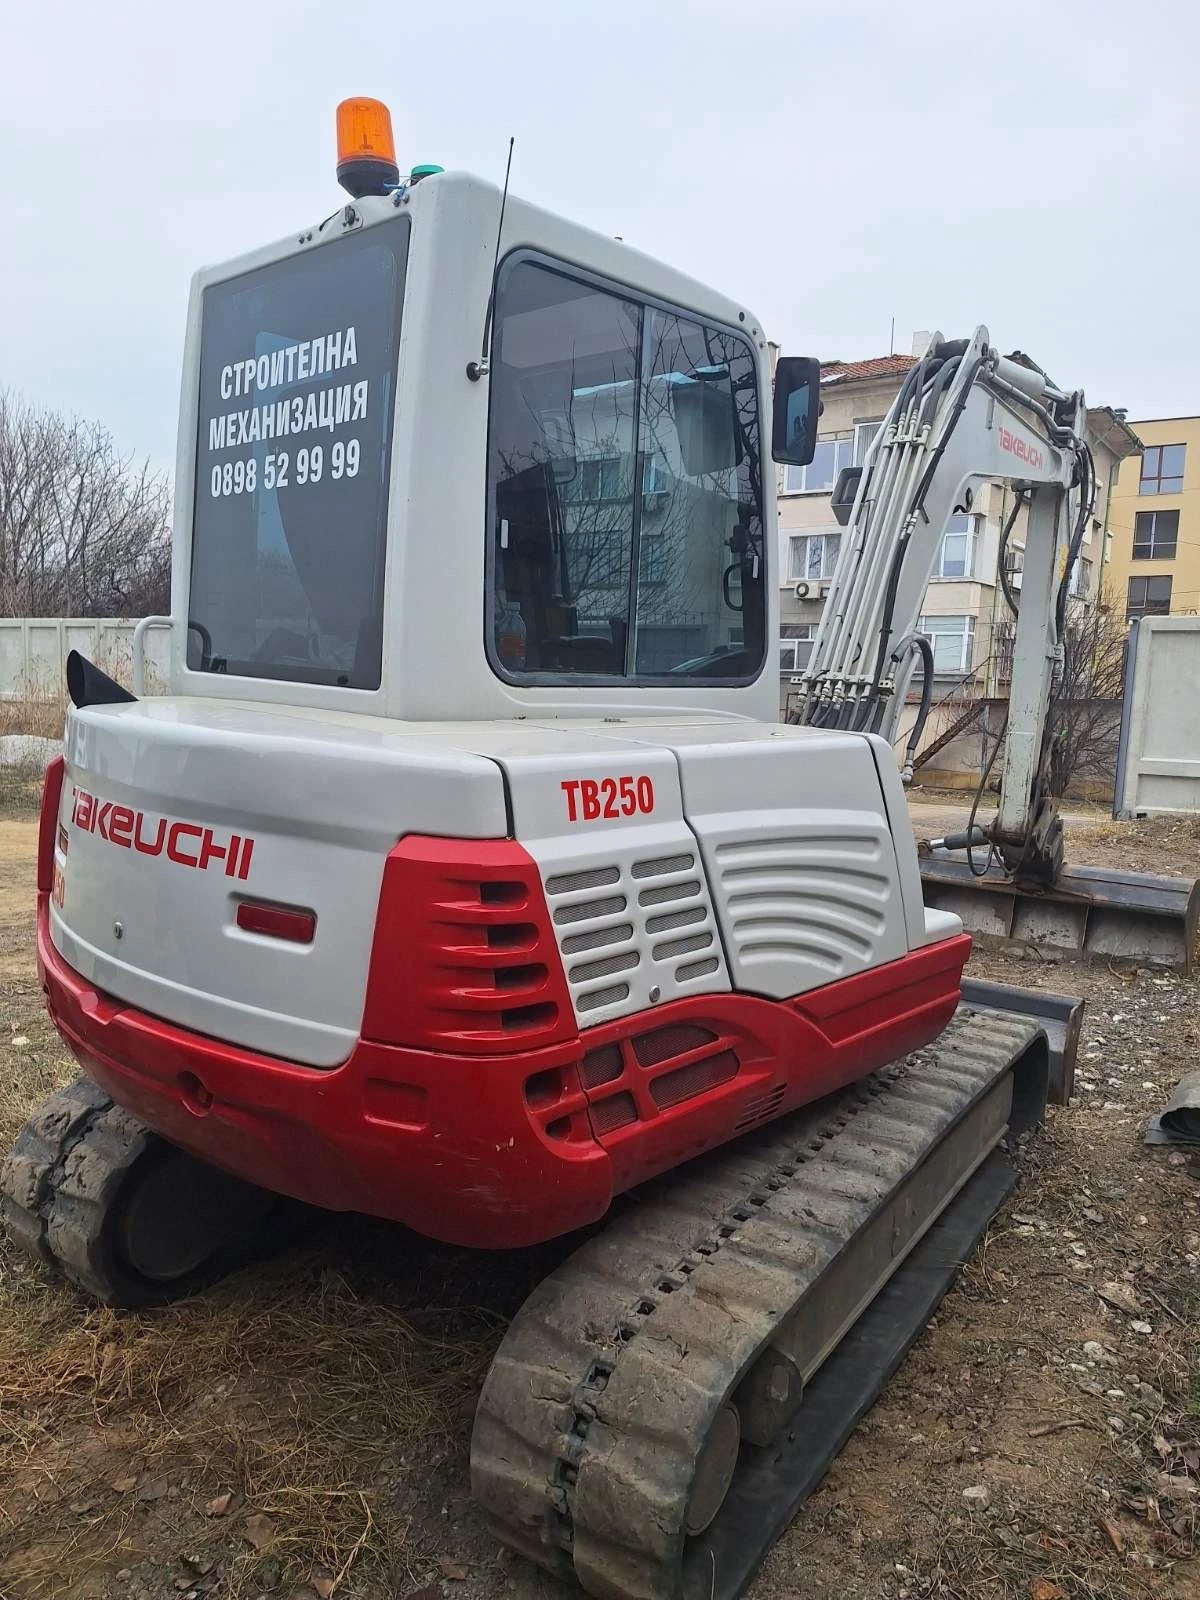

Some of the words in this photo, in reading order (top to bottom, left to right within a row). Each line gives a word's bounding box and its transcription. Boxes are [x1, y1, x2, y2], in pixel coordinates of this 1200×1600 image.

[220, 326, 358, 400] СТРОИТЕЛНА
[208, 379, 369, 451] МЕХАНИЗАЦИЯ
[210, 458, 257, 498] 0898
[263, 451, 290, 490] 52
[296, 445, 323, 485] 99
[331, 438, 361, 478] 99
[560, 775, 655, 822] TB250
